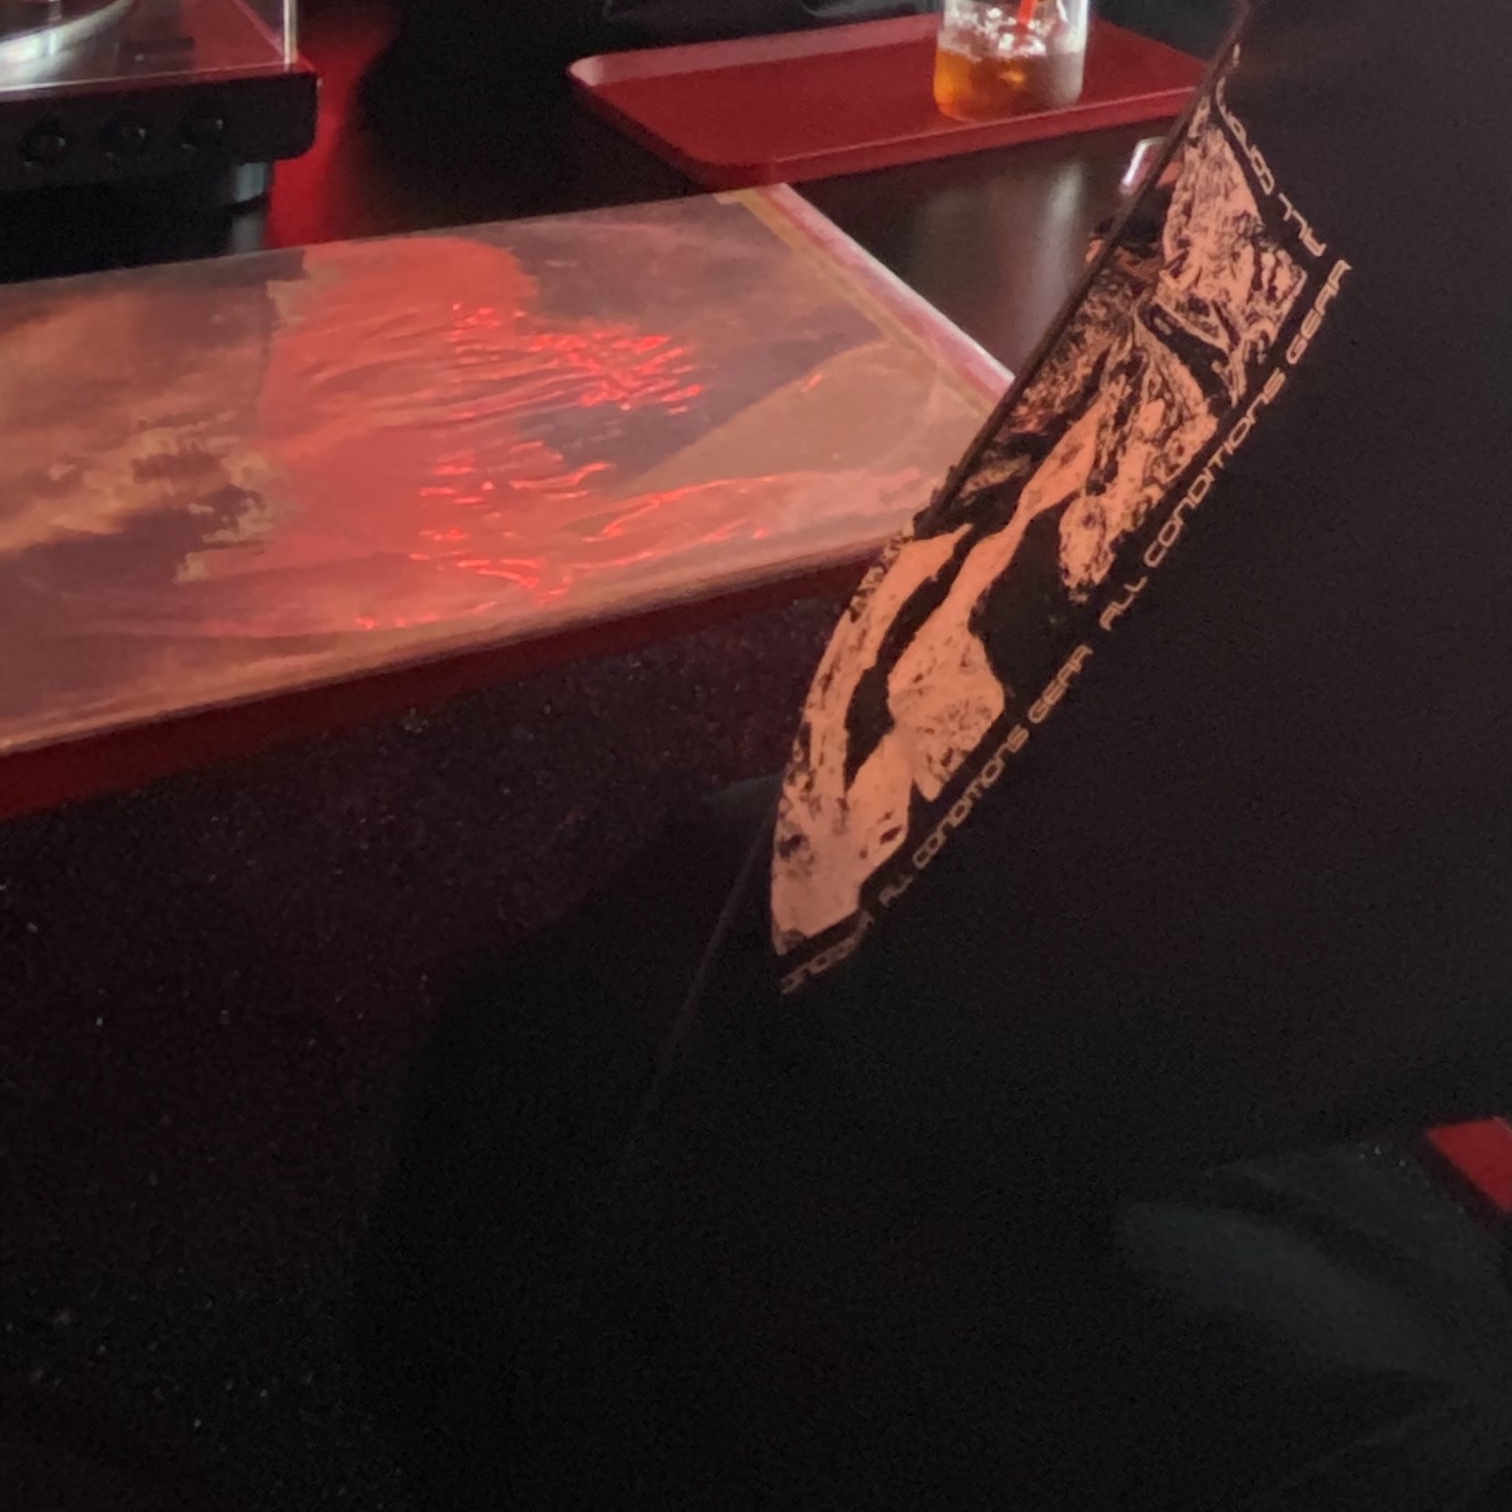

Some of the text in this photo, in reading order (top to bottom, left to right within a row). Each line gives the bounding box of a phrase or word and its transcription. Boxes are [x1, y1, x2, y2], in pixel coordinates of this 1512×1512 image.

[1278, 192, 1327, 257] ALL
[1100, 259, 1352, 631] ALL CONDITIONS GEAR
[912, 726, 1029, 869] CONDITIONS
[1027, 644, 1094, 724] GEAR
